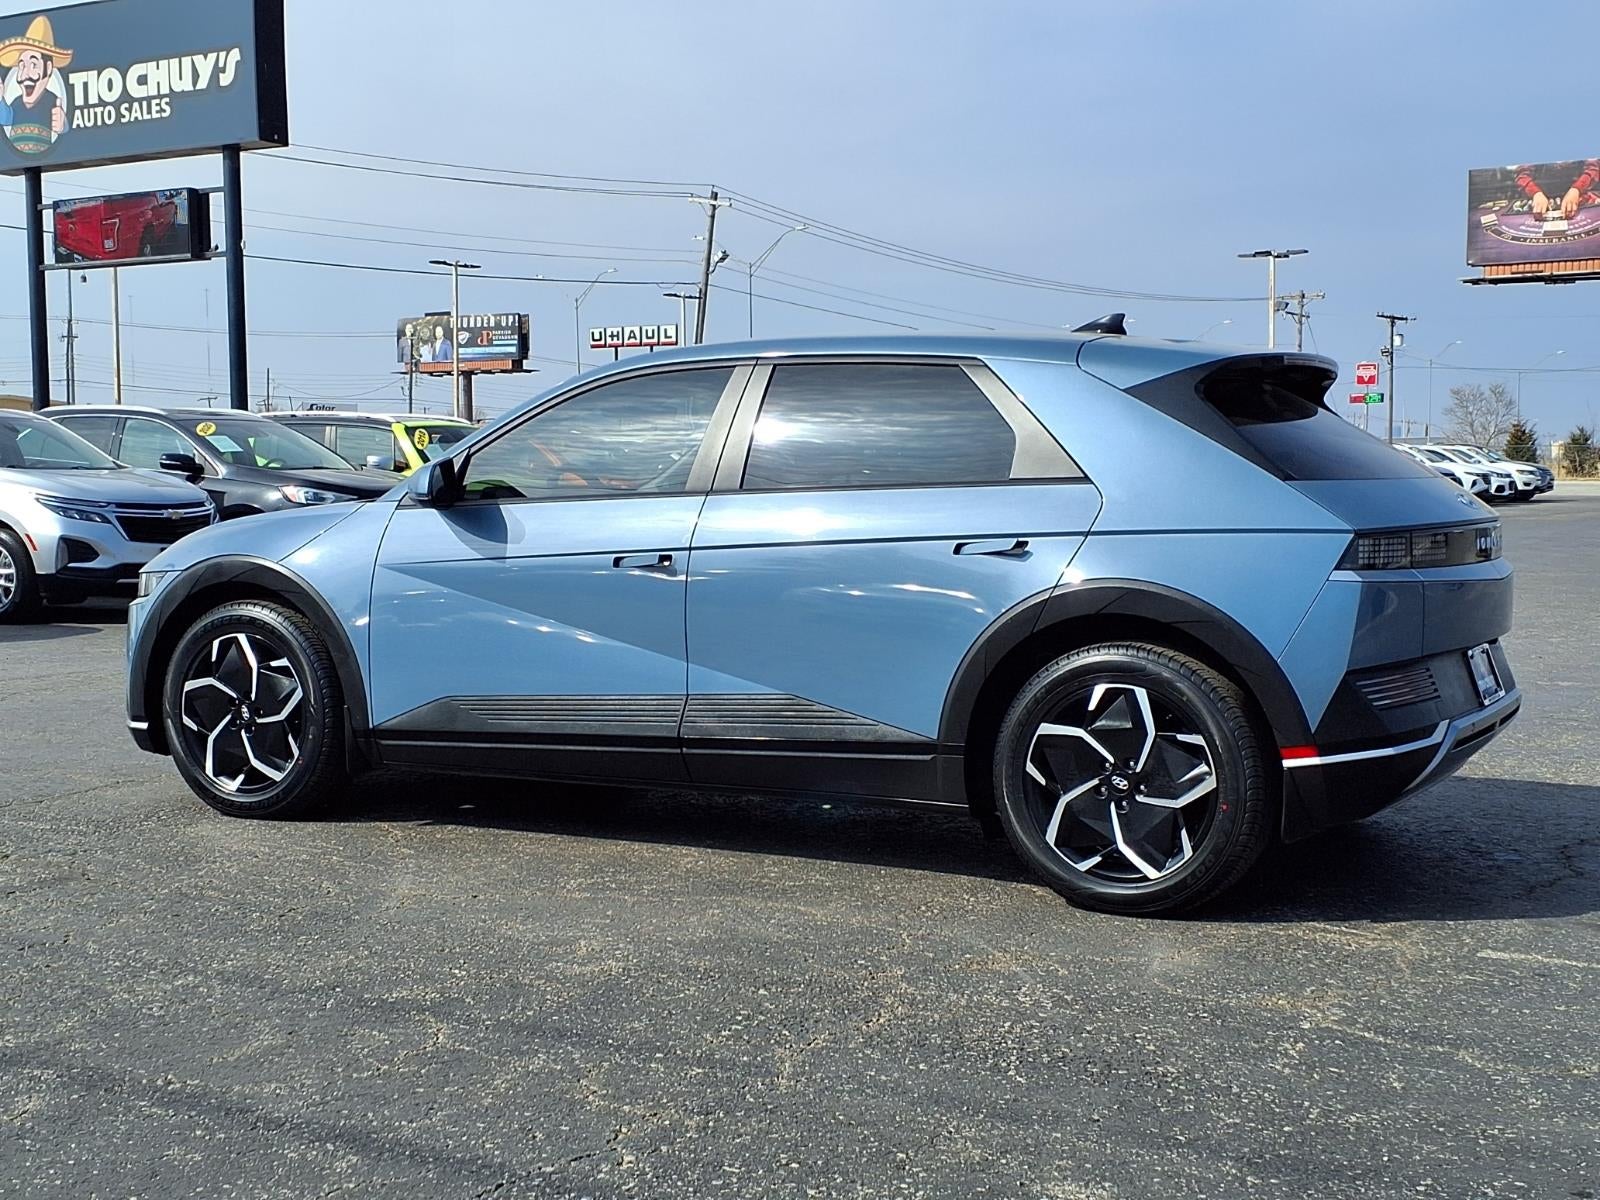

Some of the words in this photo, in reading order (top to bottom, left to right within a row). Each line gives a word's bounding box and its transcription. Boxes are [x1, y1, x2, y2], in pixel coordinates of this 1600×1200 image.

[69, 67, 123, 107] TIO
[126, 47, 241, 99] CHUY'S
[72, 104, 116, 129] AUTO
[120, 97, 171, 124] SALES
